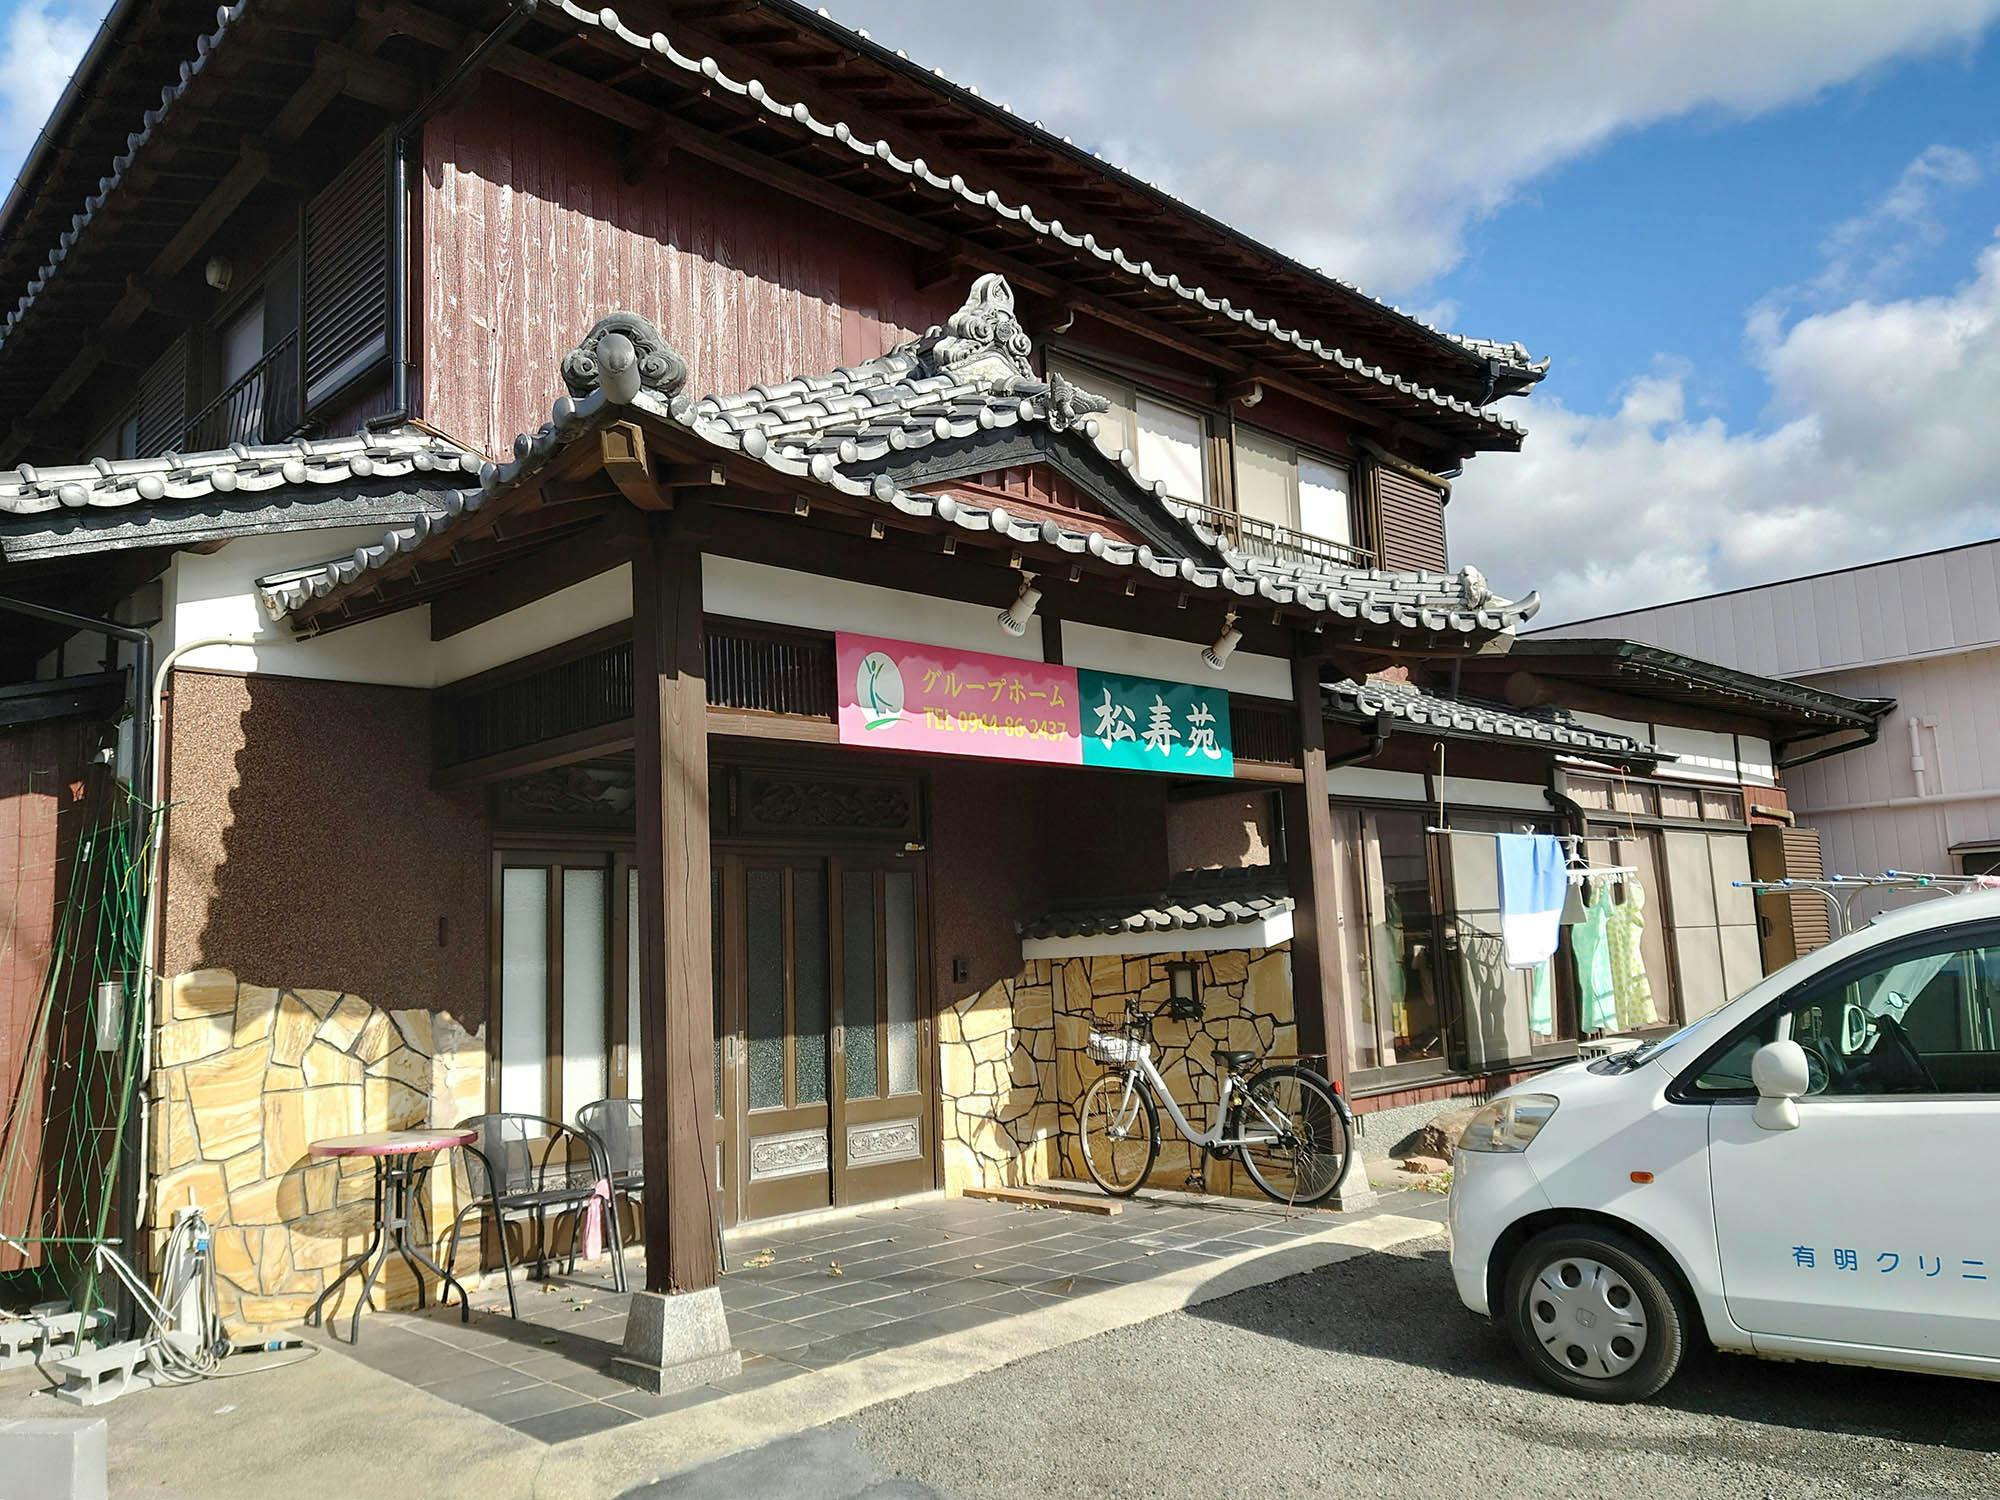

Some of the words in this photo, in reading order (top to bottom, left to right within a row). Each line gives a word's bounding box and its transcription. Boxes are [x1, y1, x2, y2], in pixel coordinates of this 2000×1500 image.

[922, 667, 1065, 708] グループホーム
[923, 706, 955, 732] TEL
[1093, 687, 1222, 760] 松寿苑
[1791, 1244, 1988, 1281] 有明クリニ
